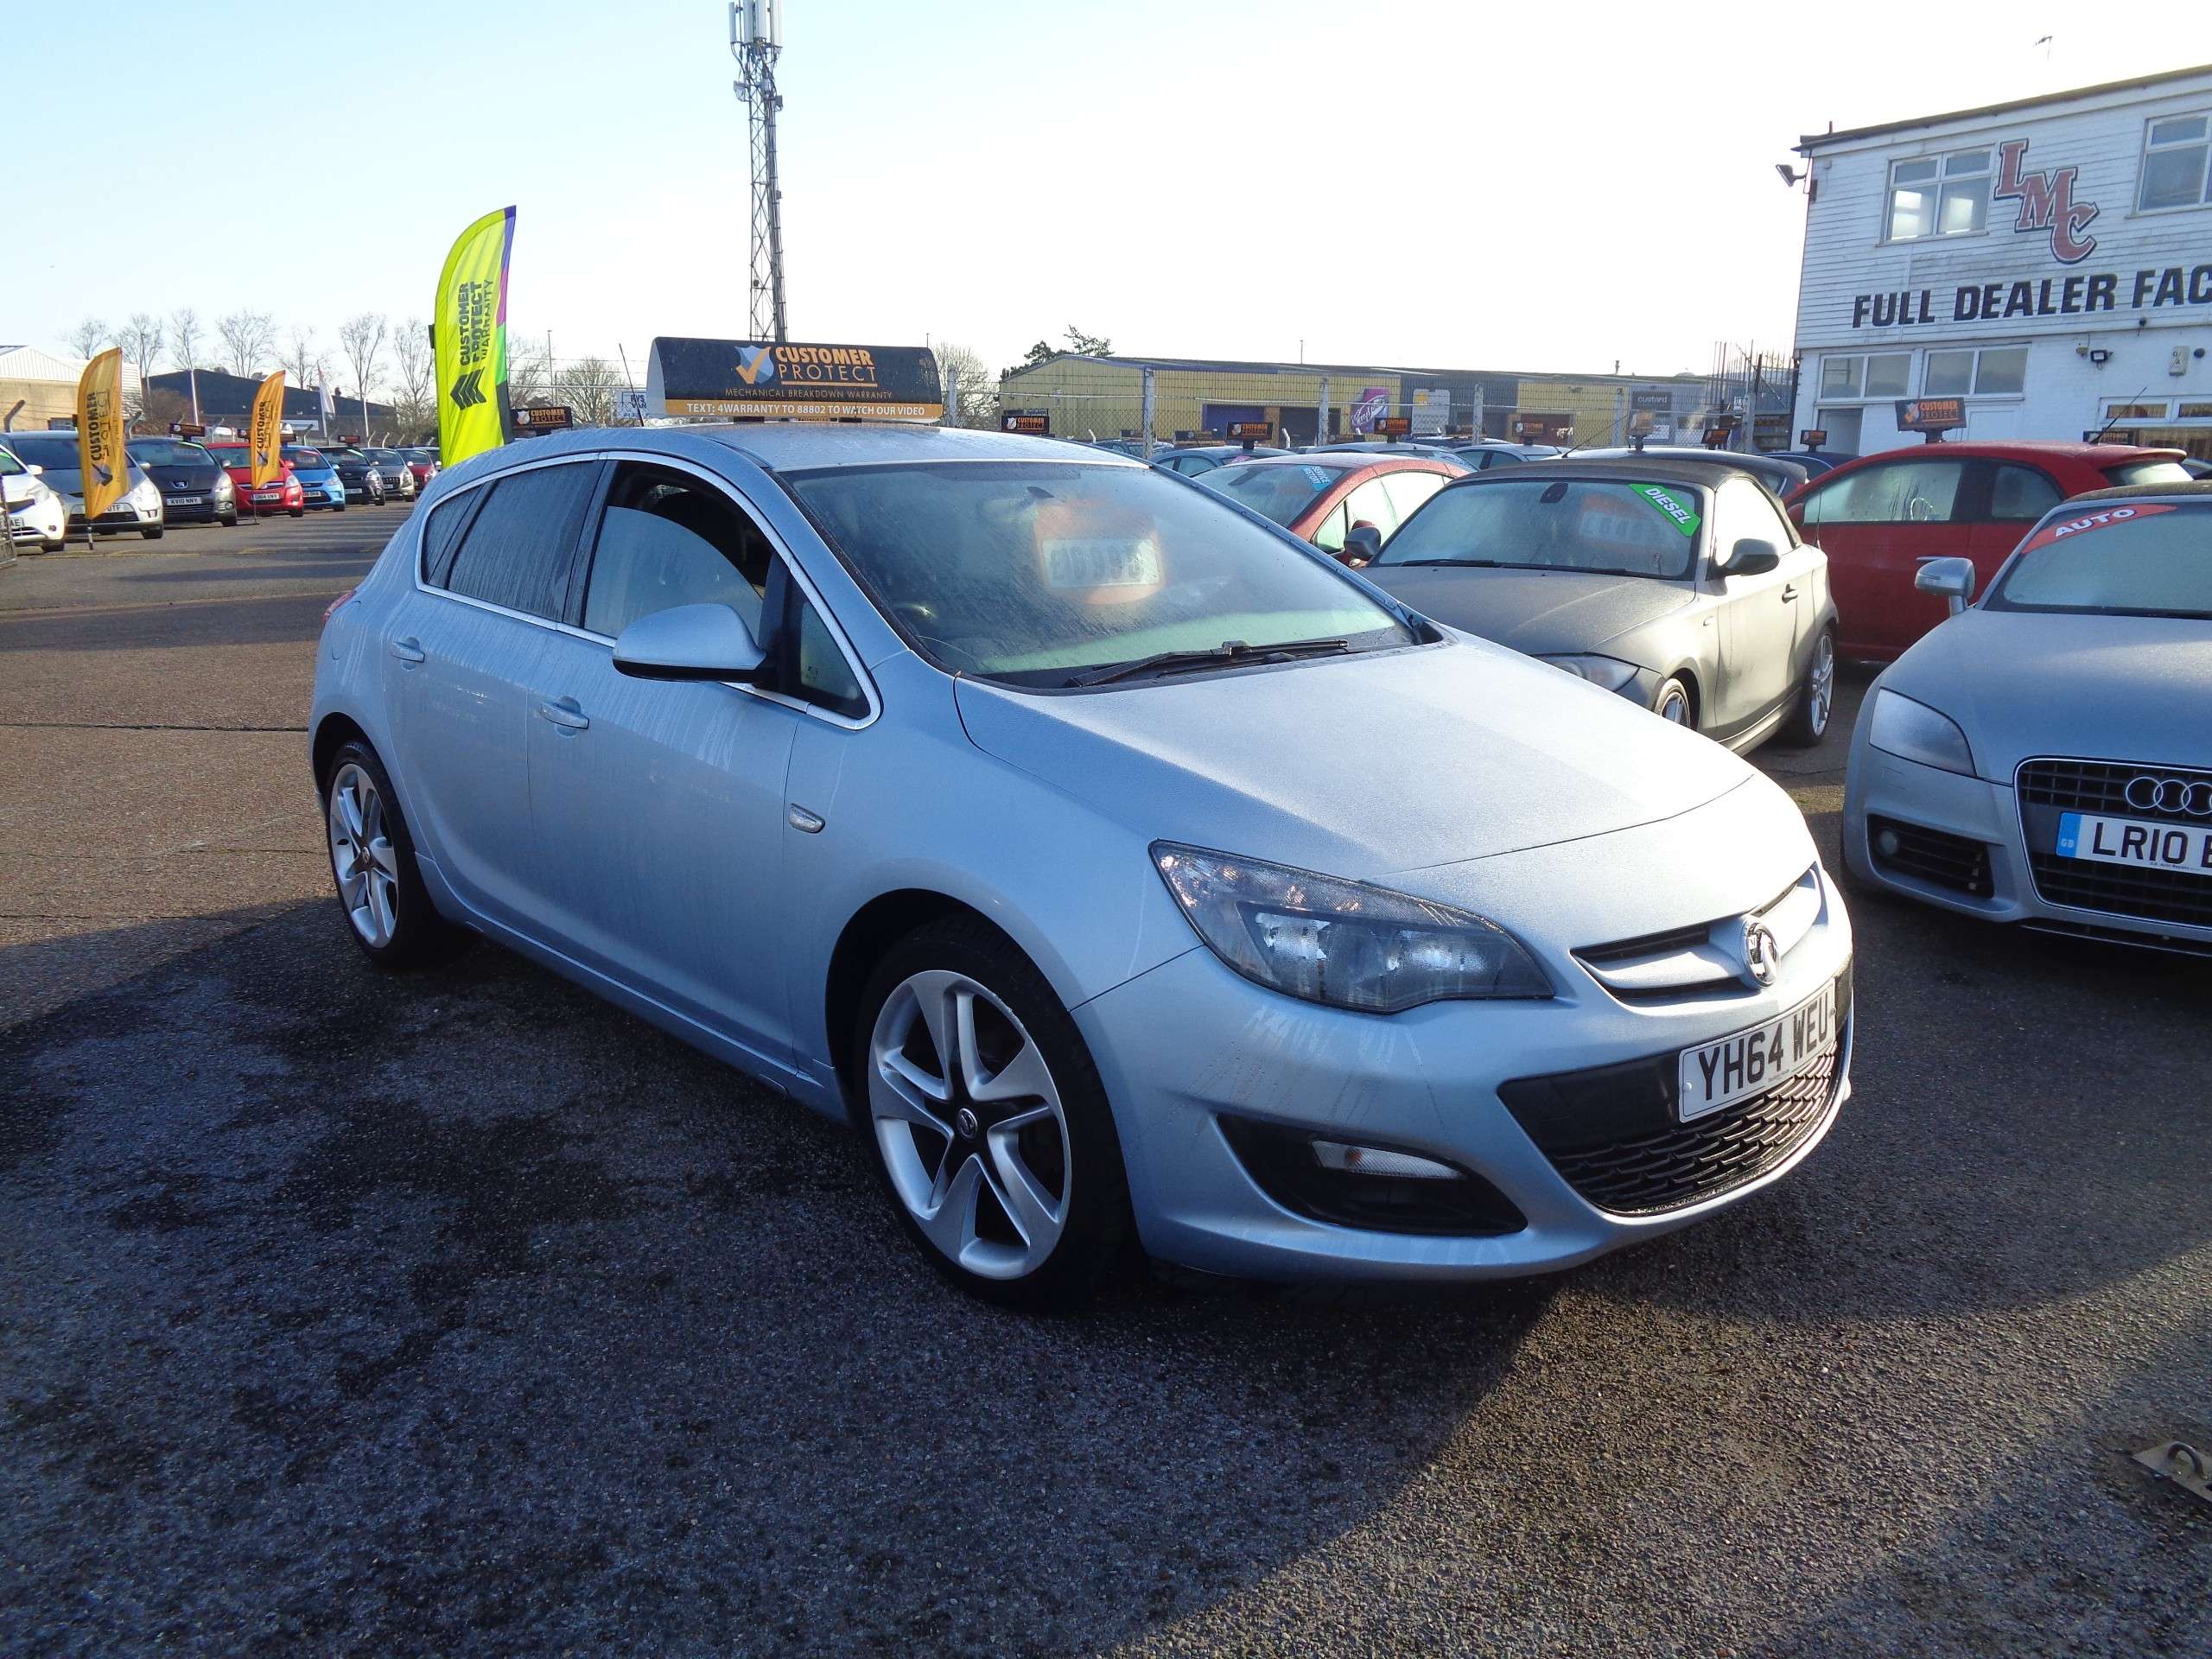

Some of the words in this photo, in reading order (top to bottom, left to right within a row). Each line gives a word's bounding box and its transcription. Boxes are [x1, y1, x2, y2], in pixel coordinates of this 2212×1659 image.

[1994, 138, 2100, 264] LMC
[1852, 290, 1936, 327] FULL
[1954, 274, 2118, 321] DEALER
[458, 283, 470, 365] CUSTOMER
[471, 282, 483, 363] PROTECT
[776, 346, 874, 365] CUSTOMER
[779, 364, 875, 381] PROTECT
[687, 403, 715, 413] TEXT:
[717, 404, 780, 414] 4WARRANTY
[781, 404, 796, 414] TO
[797, 404, 826, 414] 88802
[828, 405, 840, 414] TO
[842, 405, 874, 415] WATCH
[876, 406, 896, 415] OUR
[898, 406, 925, 416] VIDEO
[725, 389, 785, 397] MECHANICAL
[788, 389, 844, 398] BREAKDOWN
[1921, 400, 1958, 411] CUSTOMER
[86, 391, 102, 461] CUSTOMER
[257, 401, 266, 448] CUSTOMER
[531, 408, 565, 416] CUSTOMER
[1921, 410, 1959, 419] PROTECT
[1644, 487, 1691, 524] DIESEL
[2055, 509, 2135, 537] AUTO
[2060, 838, 2075, 849] GB
[2093, 822, 2189, 865] LR10
[1698, 1022, 1784, 1101] YH64
[1793, 992, 1828, 1063] WEU
